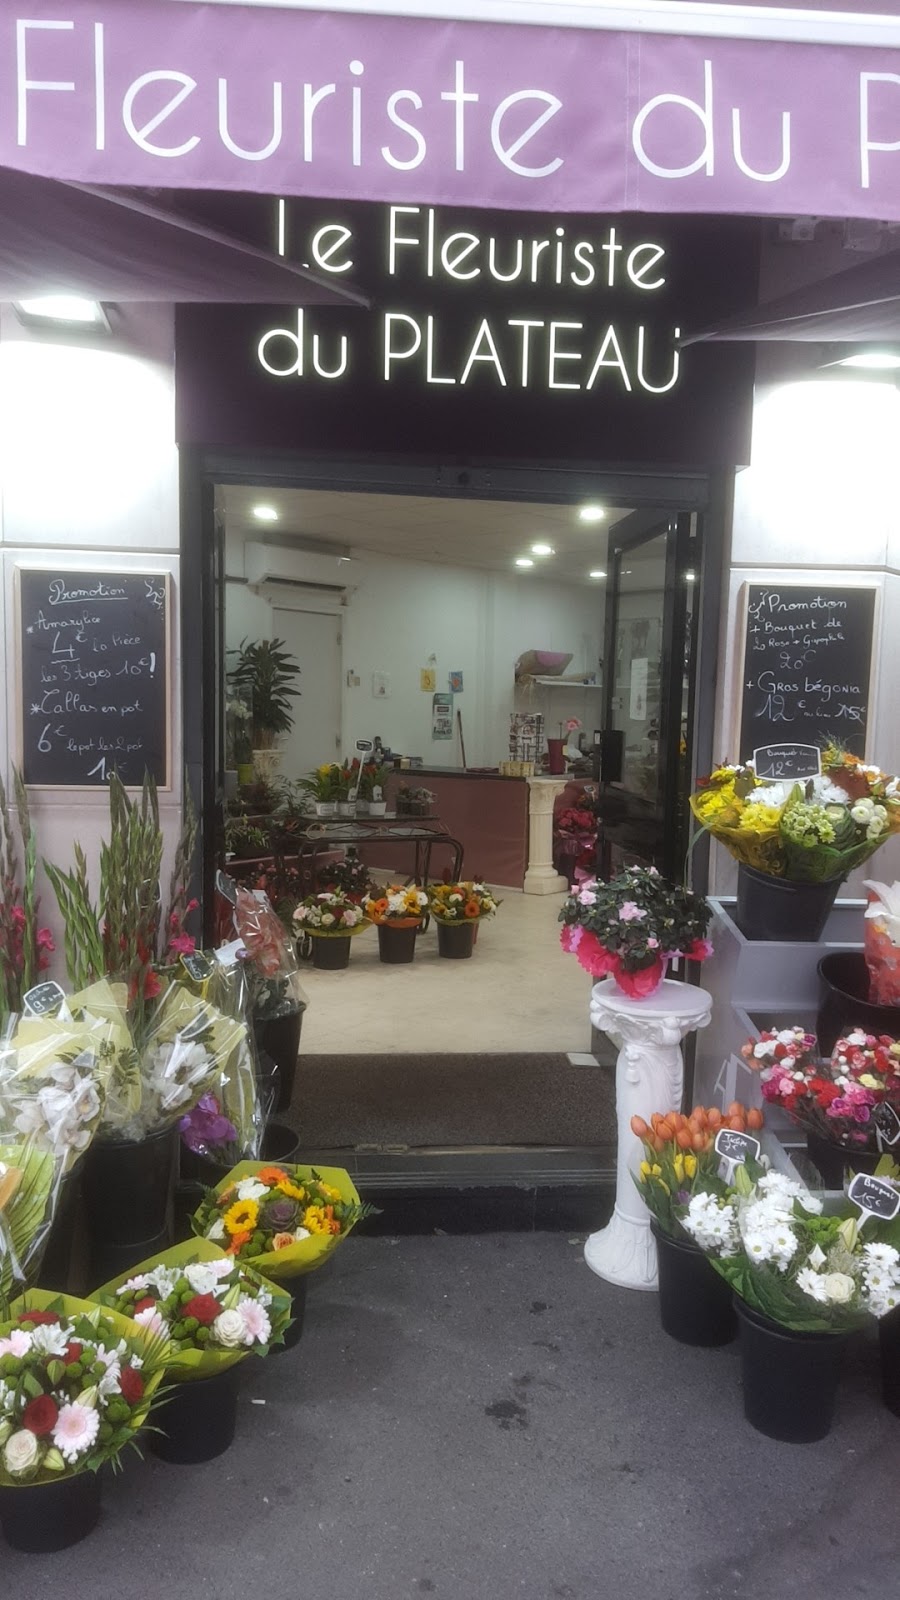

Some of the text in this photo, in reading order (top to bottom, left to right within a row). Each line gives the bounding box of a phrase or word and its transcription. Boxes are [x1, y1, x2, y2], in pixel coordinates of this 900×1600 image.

[15, 19, 565, 178] Fleuriste
[632, 60, 792, 182] du
[388, 206, 666, 290] Fleuriste
[257, 308, 681, 393] du PLATEAU
[49, 579, 125, 605] Promotion
[768, 593, 847, 613] Promotion
[764, 619, 817, 638] Bouquet
[823, 617, 842, 628] de
[41, 665, 57, 682] les
[61, 665, 71, 681] 3
[74, 664, 111, 686] tiges
[101, 704, 117, 713] en
[120, 700, 143, 716] pot
